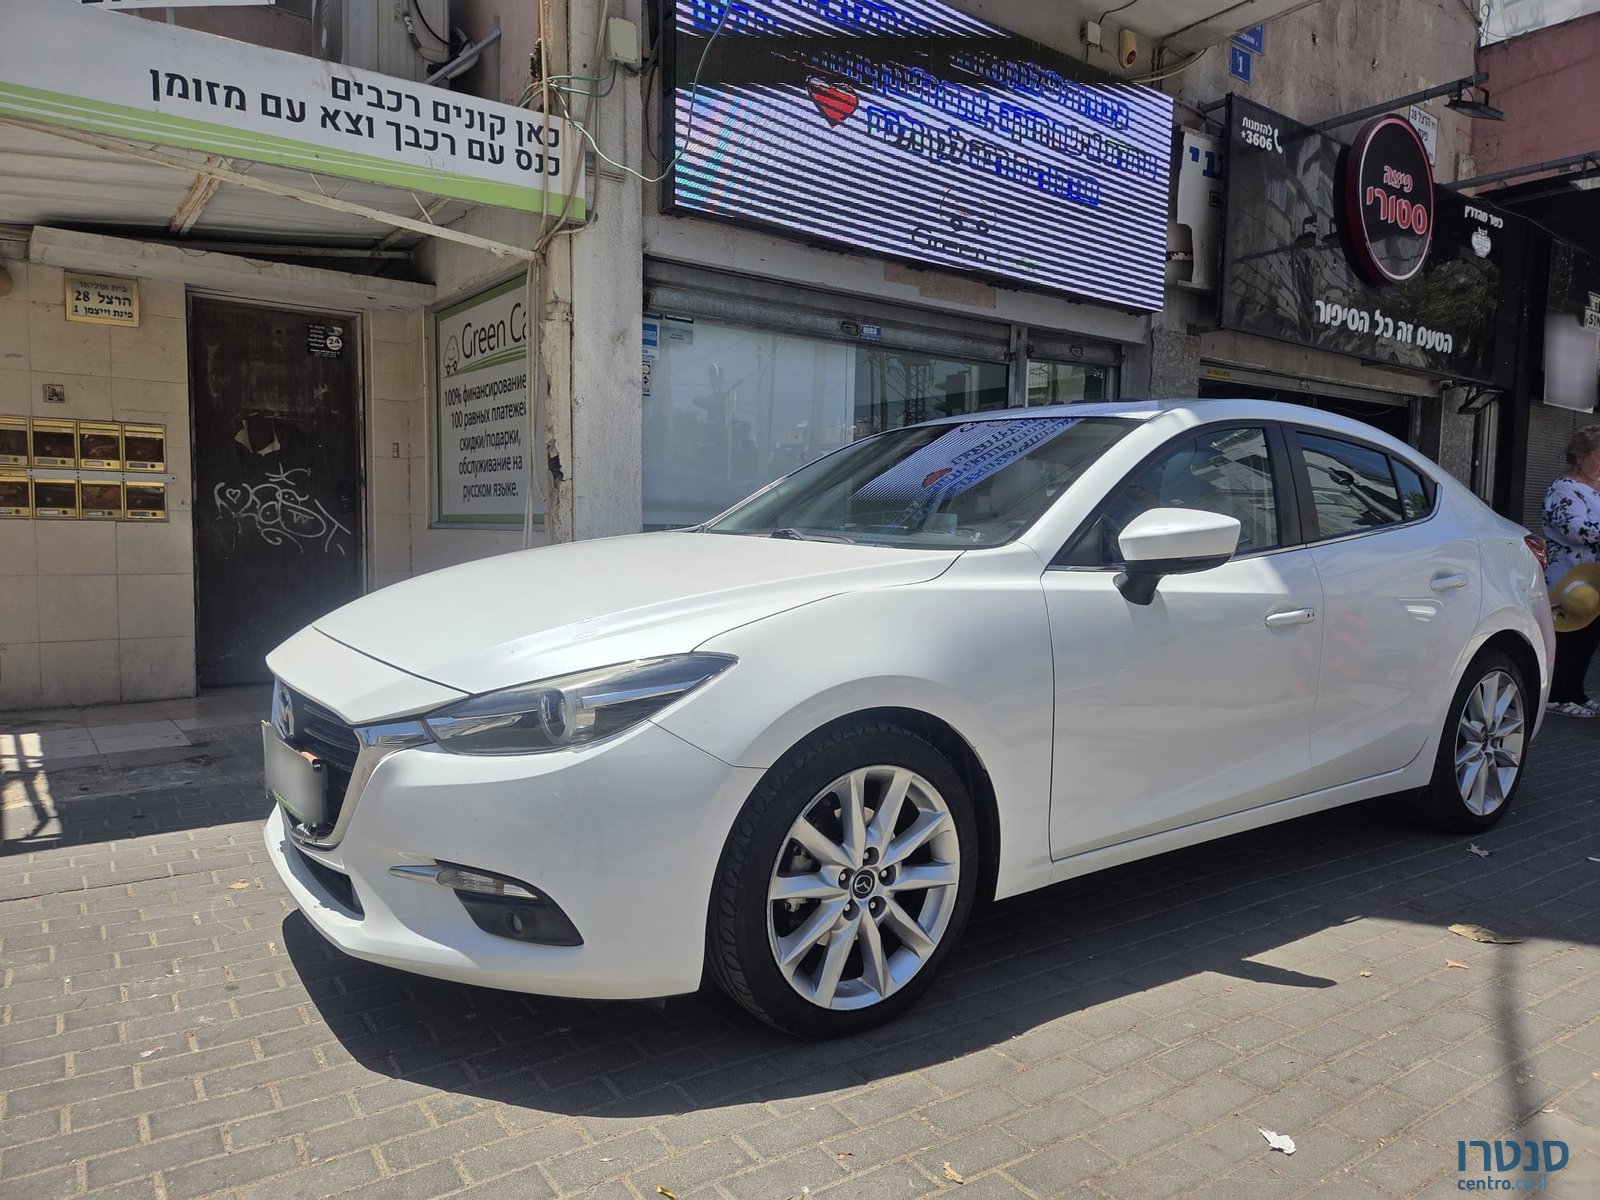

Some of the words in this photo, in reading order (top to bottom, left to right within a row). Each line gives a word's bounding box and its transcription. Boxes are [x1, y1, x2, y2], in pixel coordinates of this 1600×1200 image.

[149, 68, 247, 112] מזומן
[331, 76, 421, 117] רכבים
[260, 92, 306, 123] עם
[433, 101, 506, 140] קונים
[320, 105, 374, 138] וצא
[516, 120, 560, 147] כאן
[1242, 116, 1273, 136] להזמנות
[386, 120, 456, 155] רכבך
[468, 138, 505, 164] עם
[515, 149, 560, 176] כנס
[1383, 165, 1413, 193] פיצה
[1366, 186, 1428, 235] סטורי
[1464, 205, 1488, 223] מהדרין
[1489, 214, 1504, 229] כשר
[73, 305, 79, 313] 1
[75, 290, 90, 302] 28
[97, 292, 132, 307] הרצל
[83, 306, 111, 316] וייצמן
[113, 309, 133, 319] פינת
[1315, 300, 1370, 333] הסיפור
[1374, 309, 1394, 338] כל
[461, 318, 506, 359] Green
[510, 302, 527, 342] Ca
[1397, 321, 1414, 343] זה
[1416, 326, 1453, 353] הטעם
[444, 387, 462, 407] 100%
[462, 373, 527, 408] финансирование
[451, 410, 463, 429] 100
[464, 409, 490, 431] равных
[459, 429, 521, 453] скидки/подарки,
[458, 456, 511, 478] обслуживание
[512, 455, 522, 470] на
[463, 484, 492, 502] русском
[492, 482, 519, 498] языке.
